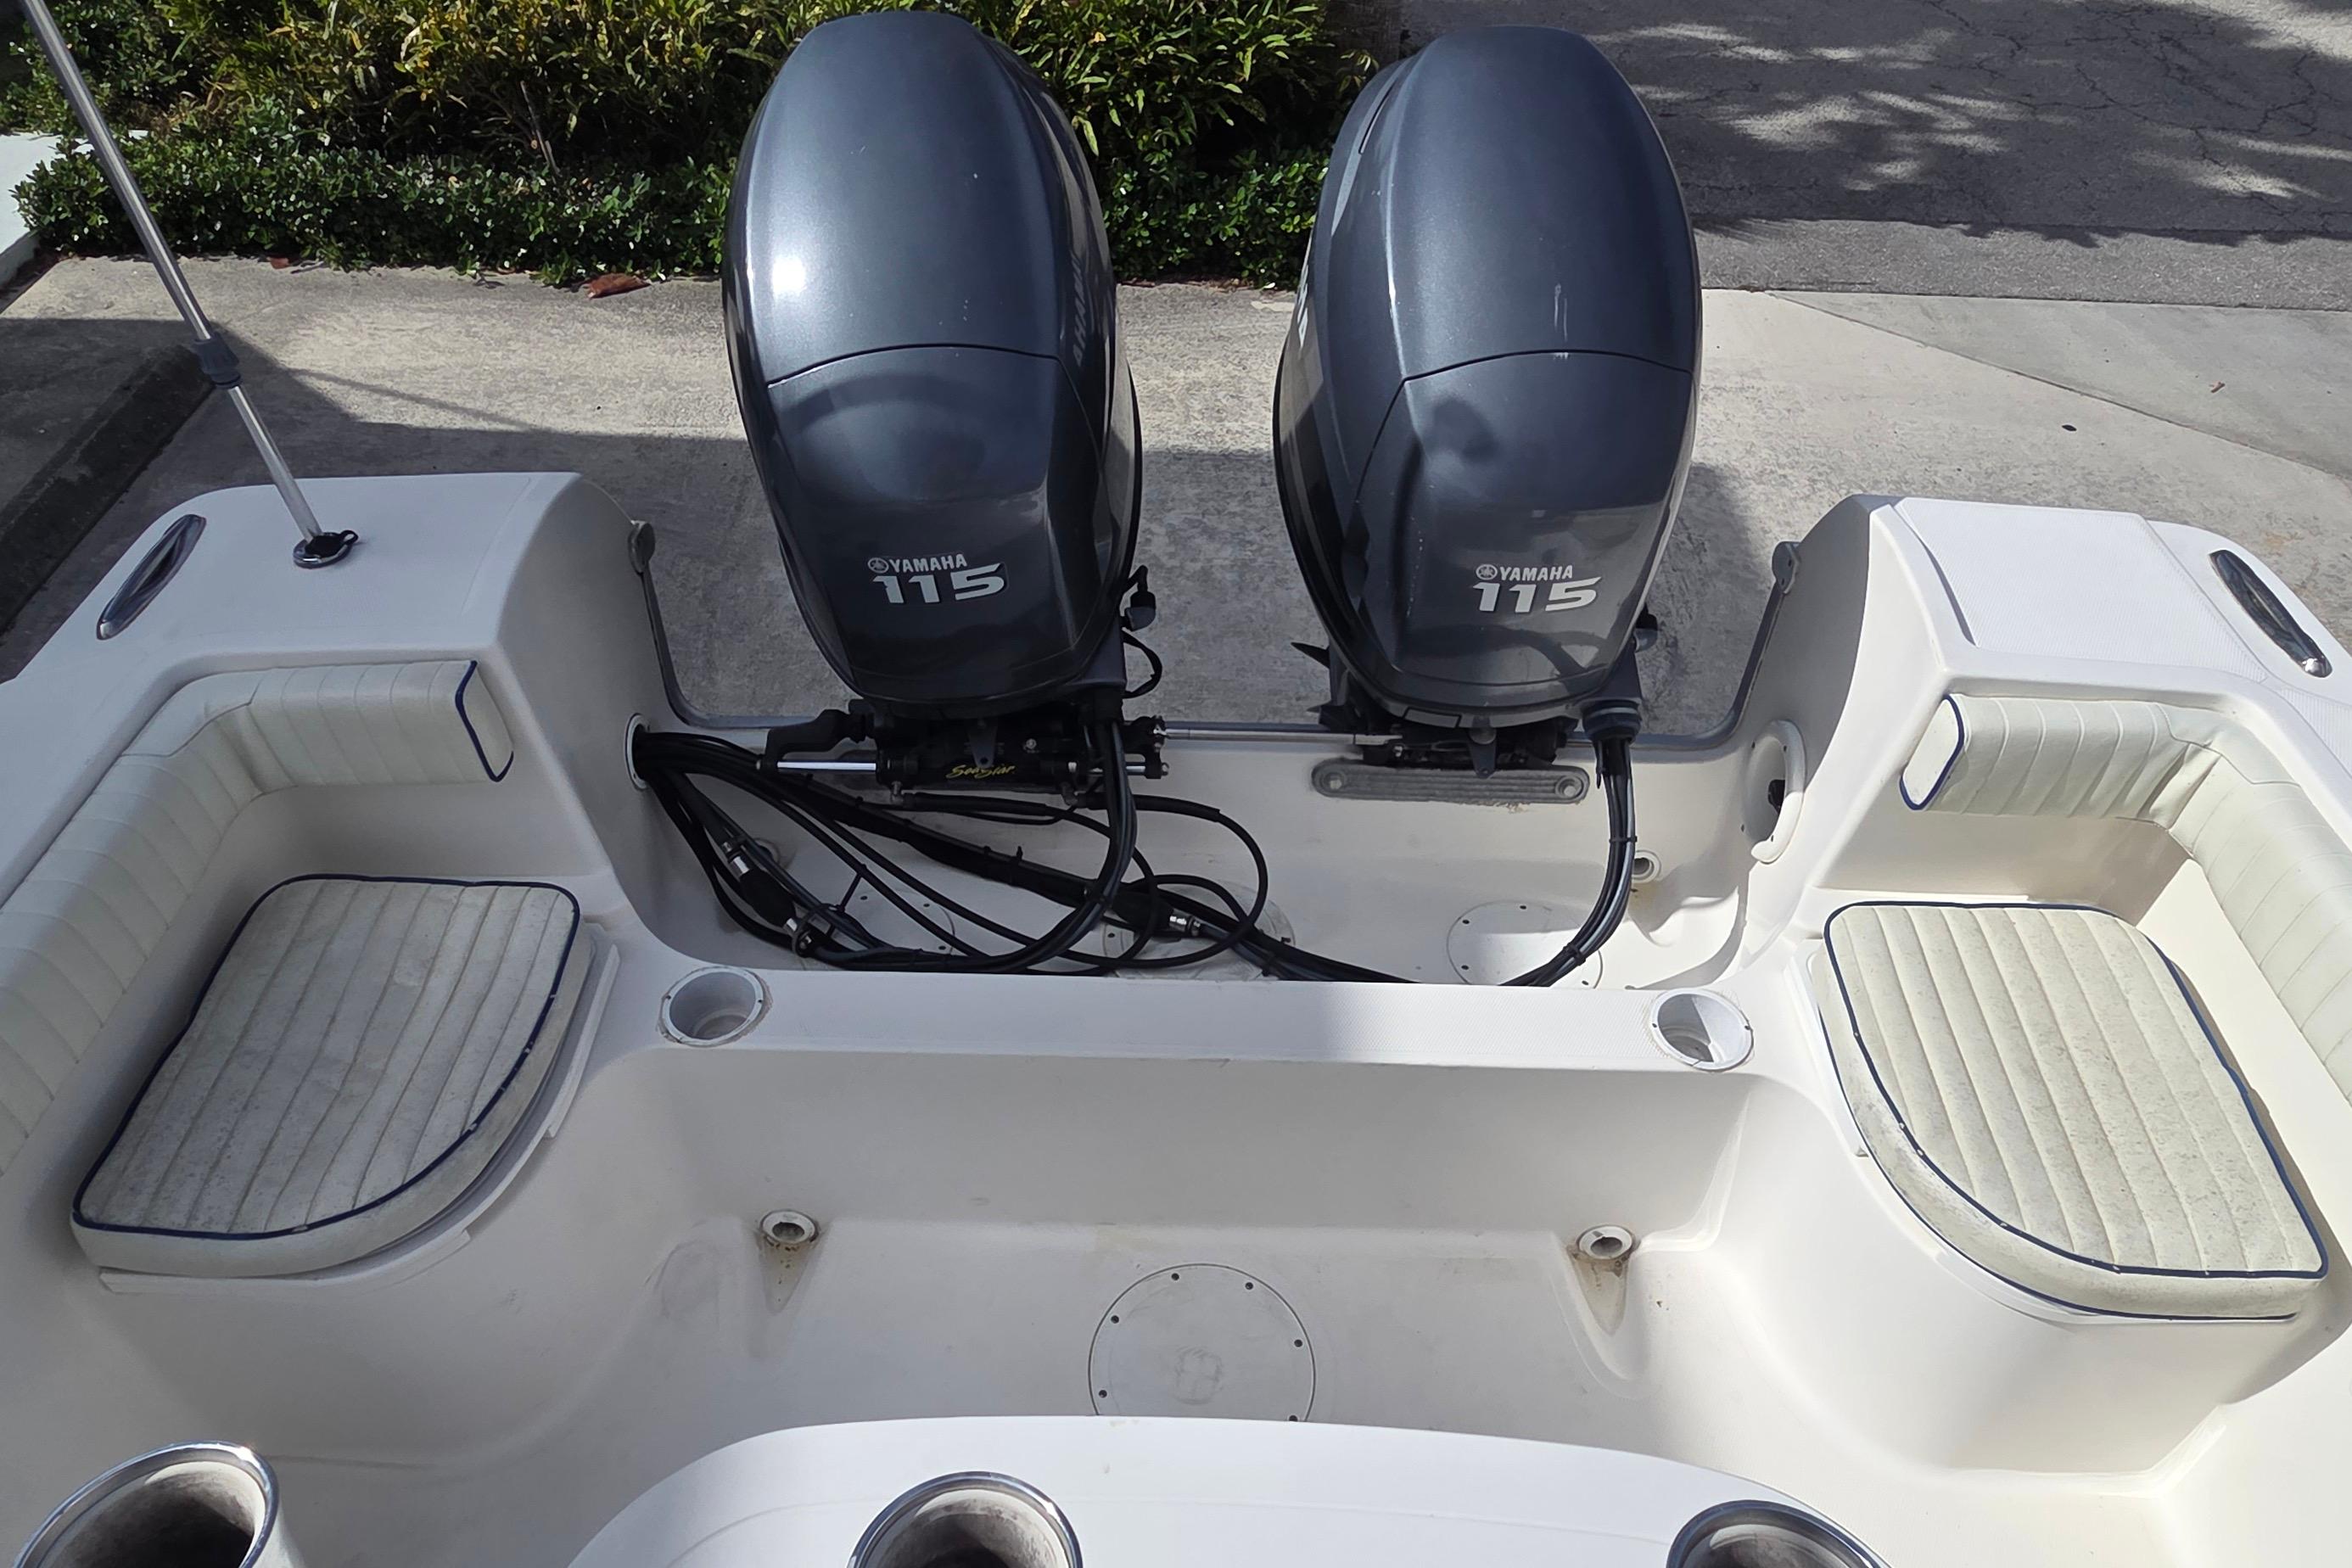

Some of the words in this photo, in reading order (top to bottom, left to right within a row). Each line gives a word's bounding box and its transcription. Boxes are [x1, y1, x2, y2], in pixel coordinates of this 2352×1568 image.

[889, 553, 968, 574] YAMAHA
[1499, 564, 1573, 581] YAMAHA
[872, 563, 1005, 604] 115
[1472, 576, 1602, 613] 115
